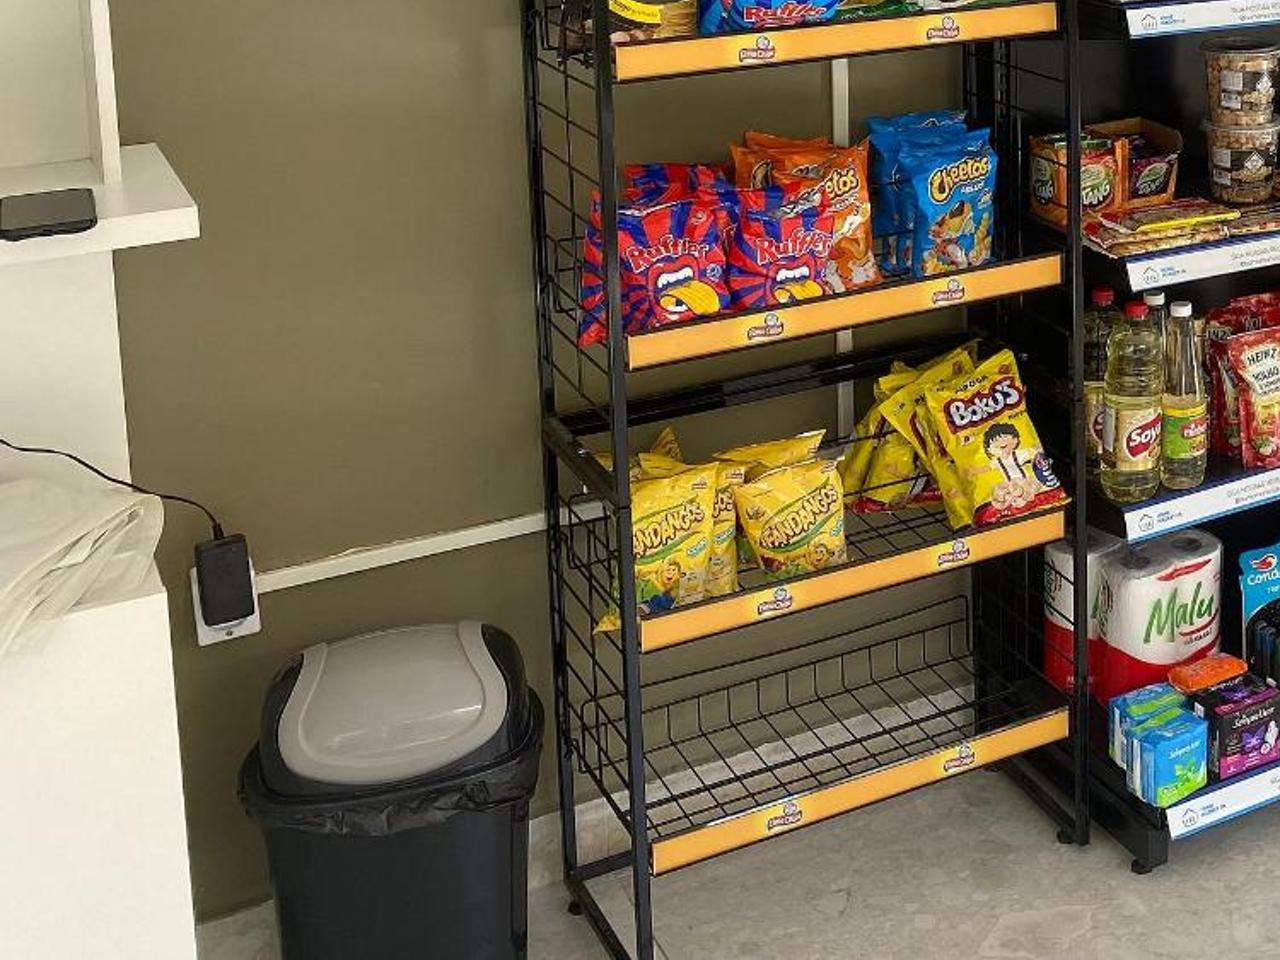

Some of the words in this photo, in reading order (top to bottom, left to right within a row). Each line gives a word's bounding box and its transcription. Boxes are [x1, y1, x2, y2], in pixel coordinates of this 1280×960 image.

[930, 157, 990, 202] Cheetos
[627, 234, 709, 273] Ruffles
[1247, 348, 1278, 365] HEINZ
[1143, 581, 1215, 644] Malu
